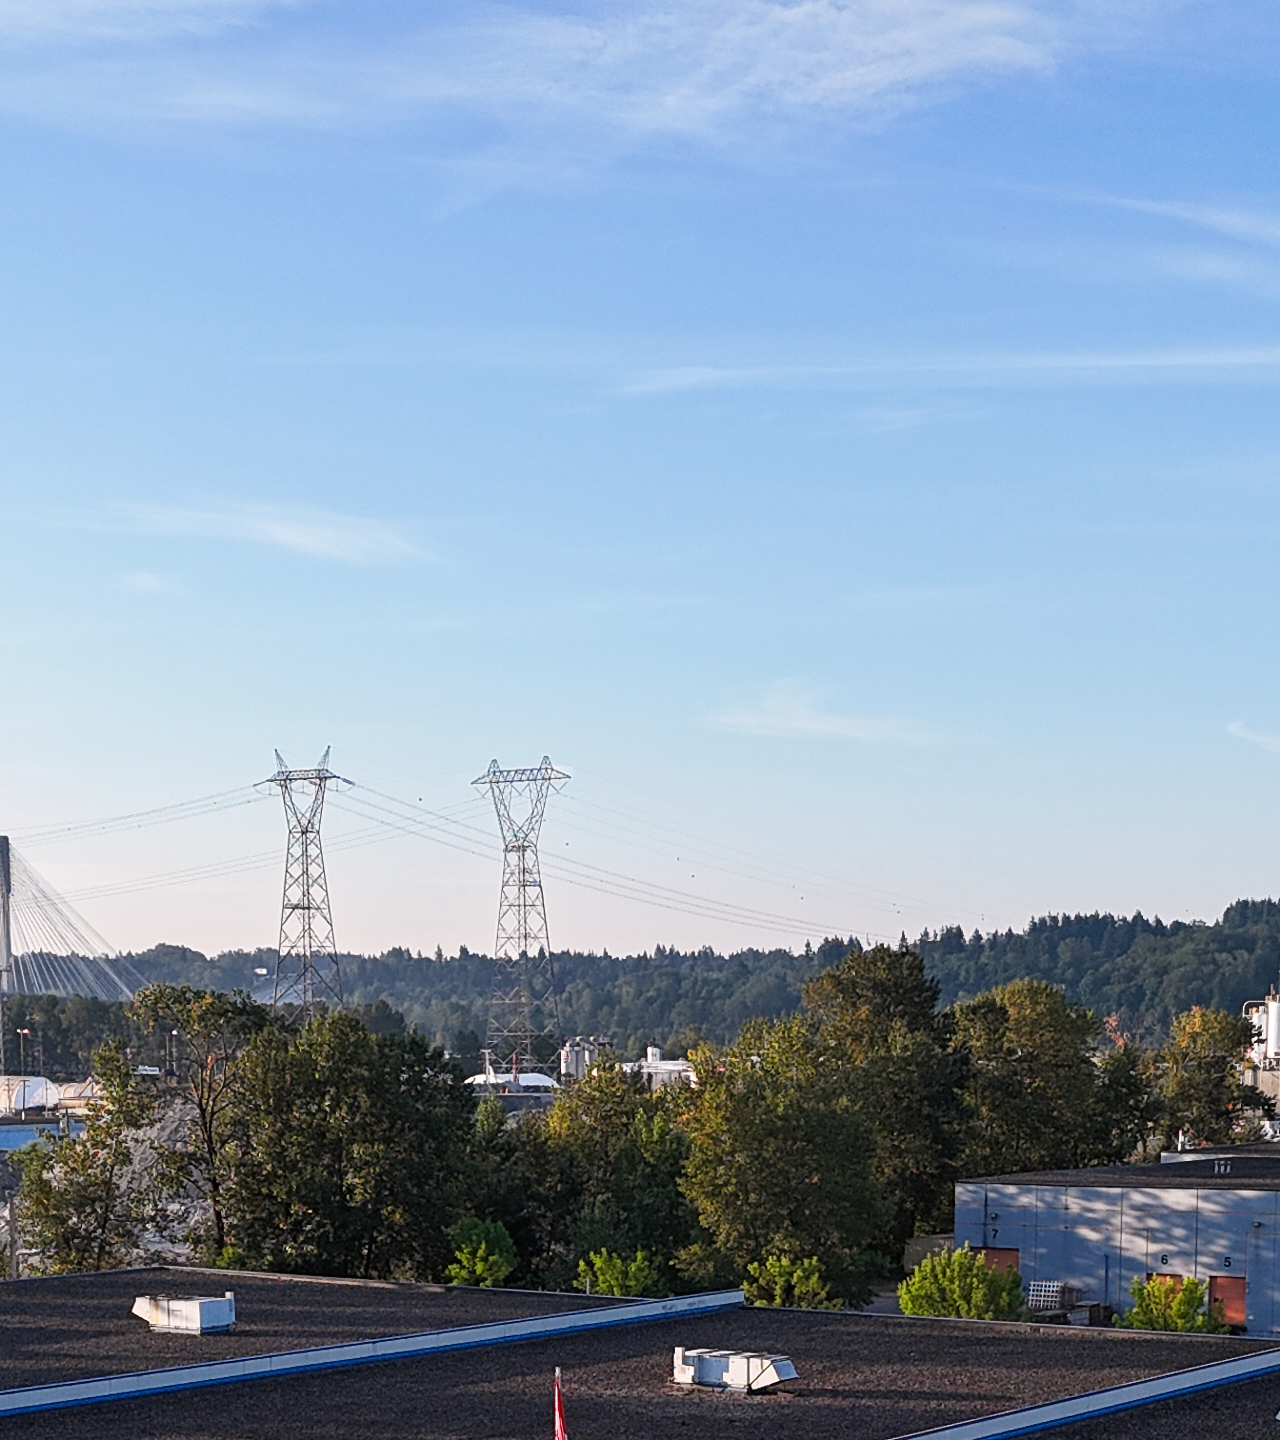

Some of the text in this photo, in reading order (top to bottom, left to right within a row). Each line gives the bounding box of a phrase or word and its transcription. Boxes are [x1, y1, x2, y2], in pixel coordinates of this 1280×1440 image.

[991, 1229, 999, 1239] 7
[1161, 1254, 1169, 1265] 6
[1223, 1256, 1232, 1267] 5
